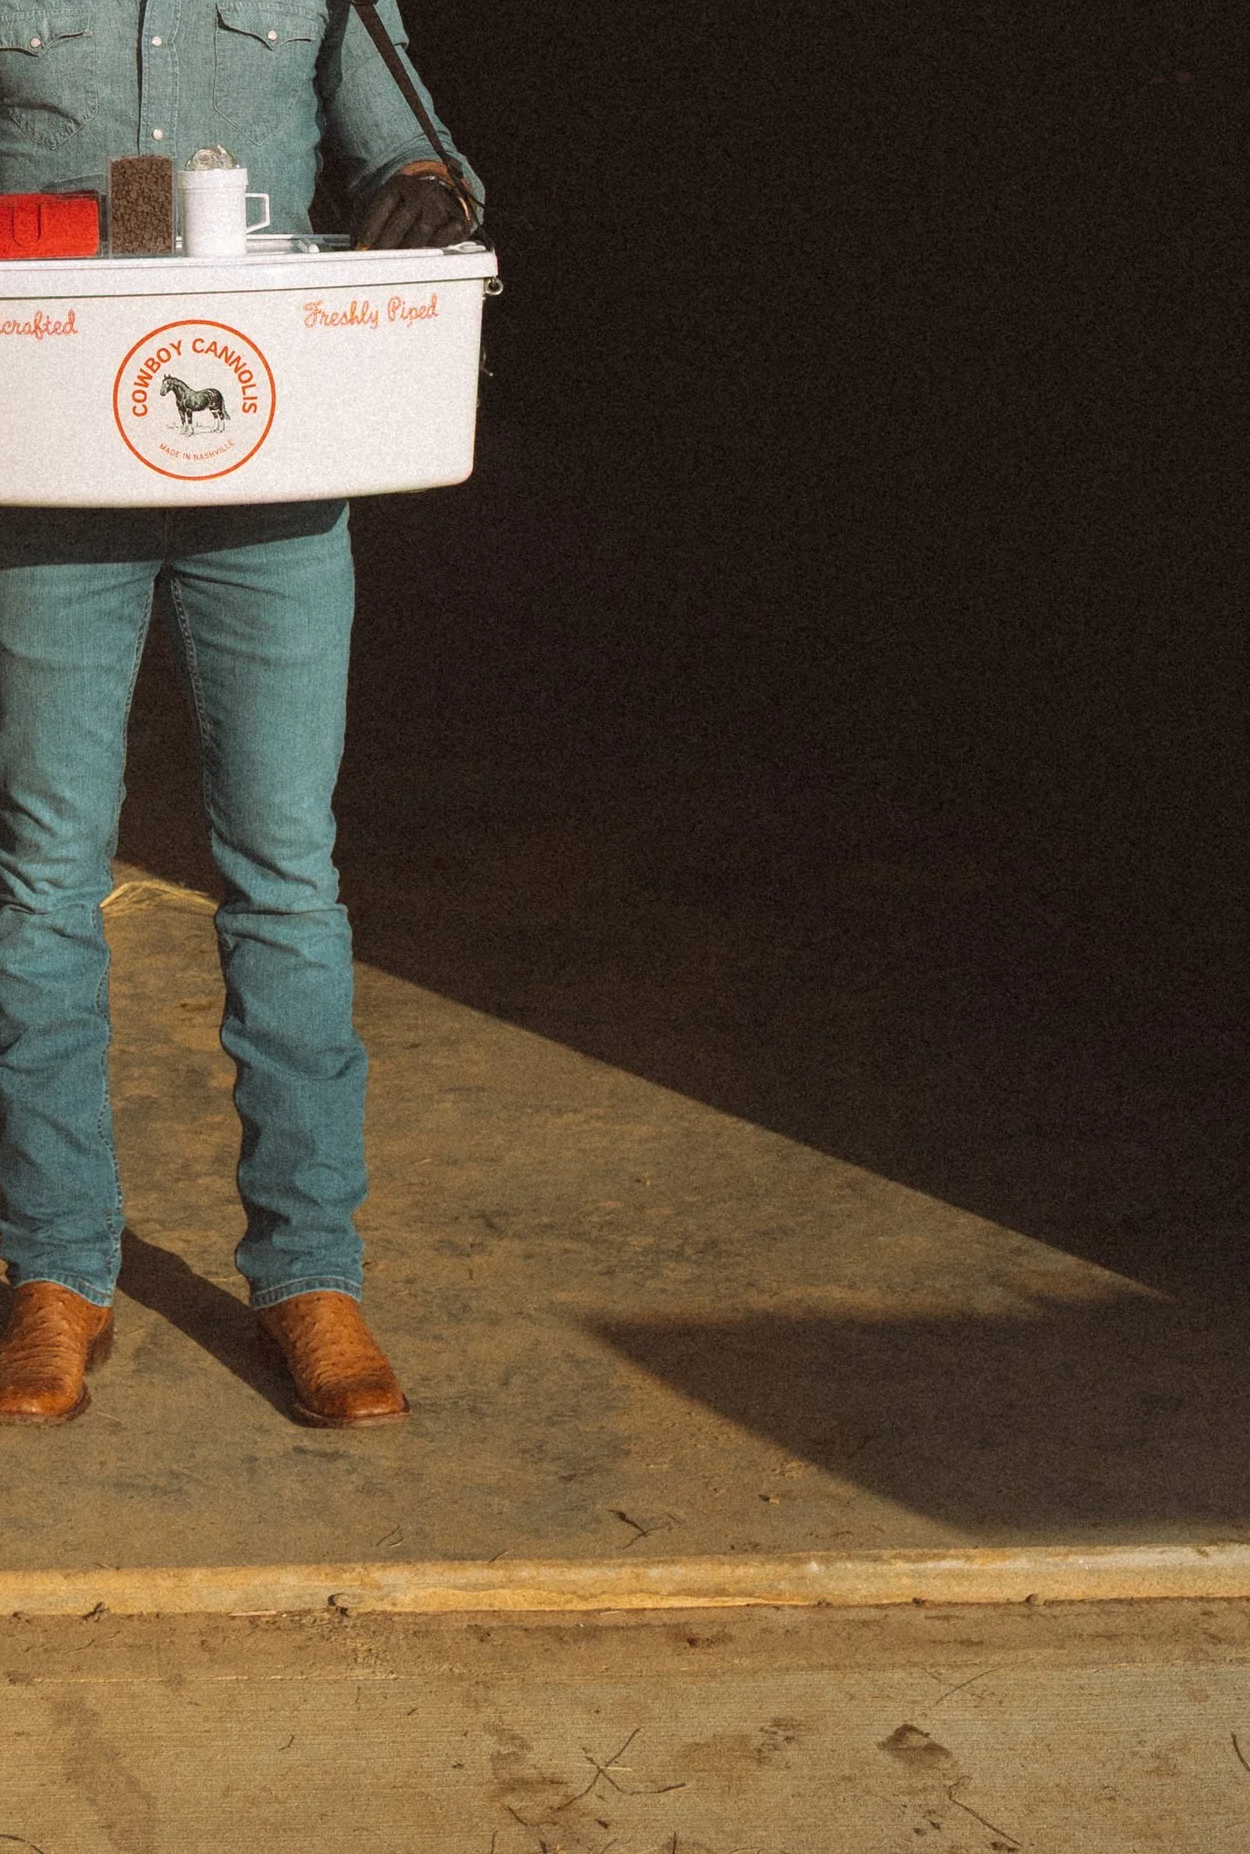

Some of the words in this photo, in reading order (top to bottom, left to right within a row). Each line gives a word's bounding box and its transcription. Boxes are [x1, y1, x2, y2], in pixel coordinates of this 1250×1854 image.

[303, 299, 378, 330] Freshly
[387, 292, 438, 327] Piped
[132, 340, 182, 418] COWBOY
[192, 338, 258, 414] CANNOLIS
[159, 443, 180, 458] MADE
[182, 452, 191, 461] IN
[193, 439, 235, 461] NASHVILLE
